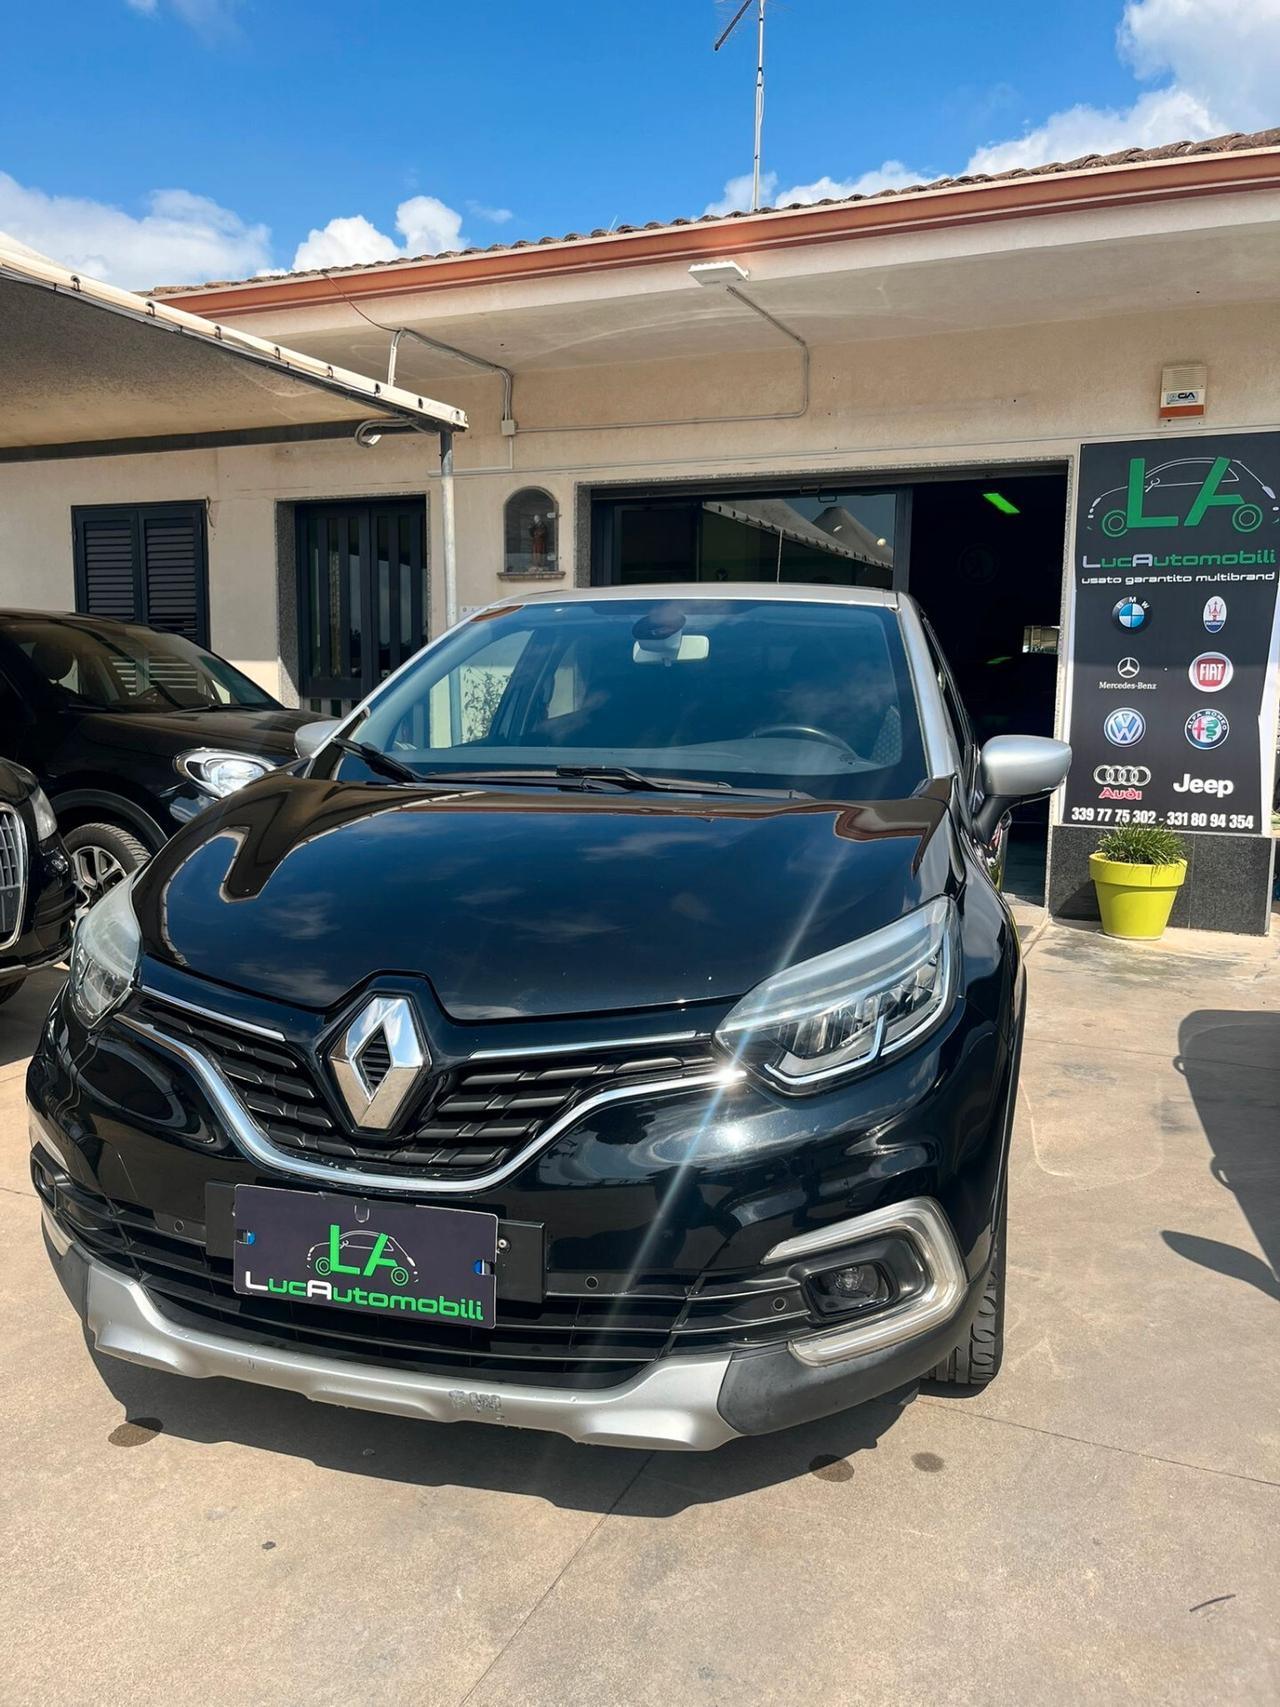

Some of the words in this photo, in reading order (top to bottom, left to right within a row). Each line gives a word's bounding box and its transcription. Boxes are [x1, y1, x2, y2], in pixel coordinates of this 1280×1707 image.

[1127, 456, 1245, 528] LA
[1082, 550, 1276, 569] LucAutomobili
[1081, 575, 1122, 584] usato
[1125, 574, 1192, 585] garantito
[1195, 572, 1275, 583] multibrand
[1199, 664, 1224, 681] FIAT
[1099, 681, 1157, 690] Mercedes-Benz
[1173, 773, 1234, 798] Jeep
[1071, 807, 1094, 821] 339
[1097, 808, 1112, 822] 77
[1115, 809, 1131, 823] 75
[1133, 810, 1156, 824] 302
[1167, 811, 1188, 826] 331
[1191, 813, 1207, 827] 80
[1210, 814, 1226, 828] 94
[1229, 815, 1254, 829] 354
[330, 1225, 398, 1276] LA
[245, 1271, 483, 1321] LucAutomobili
